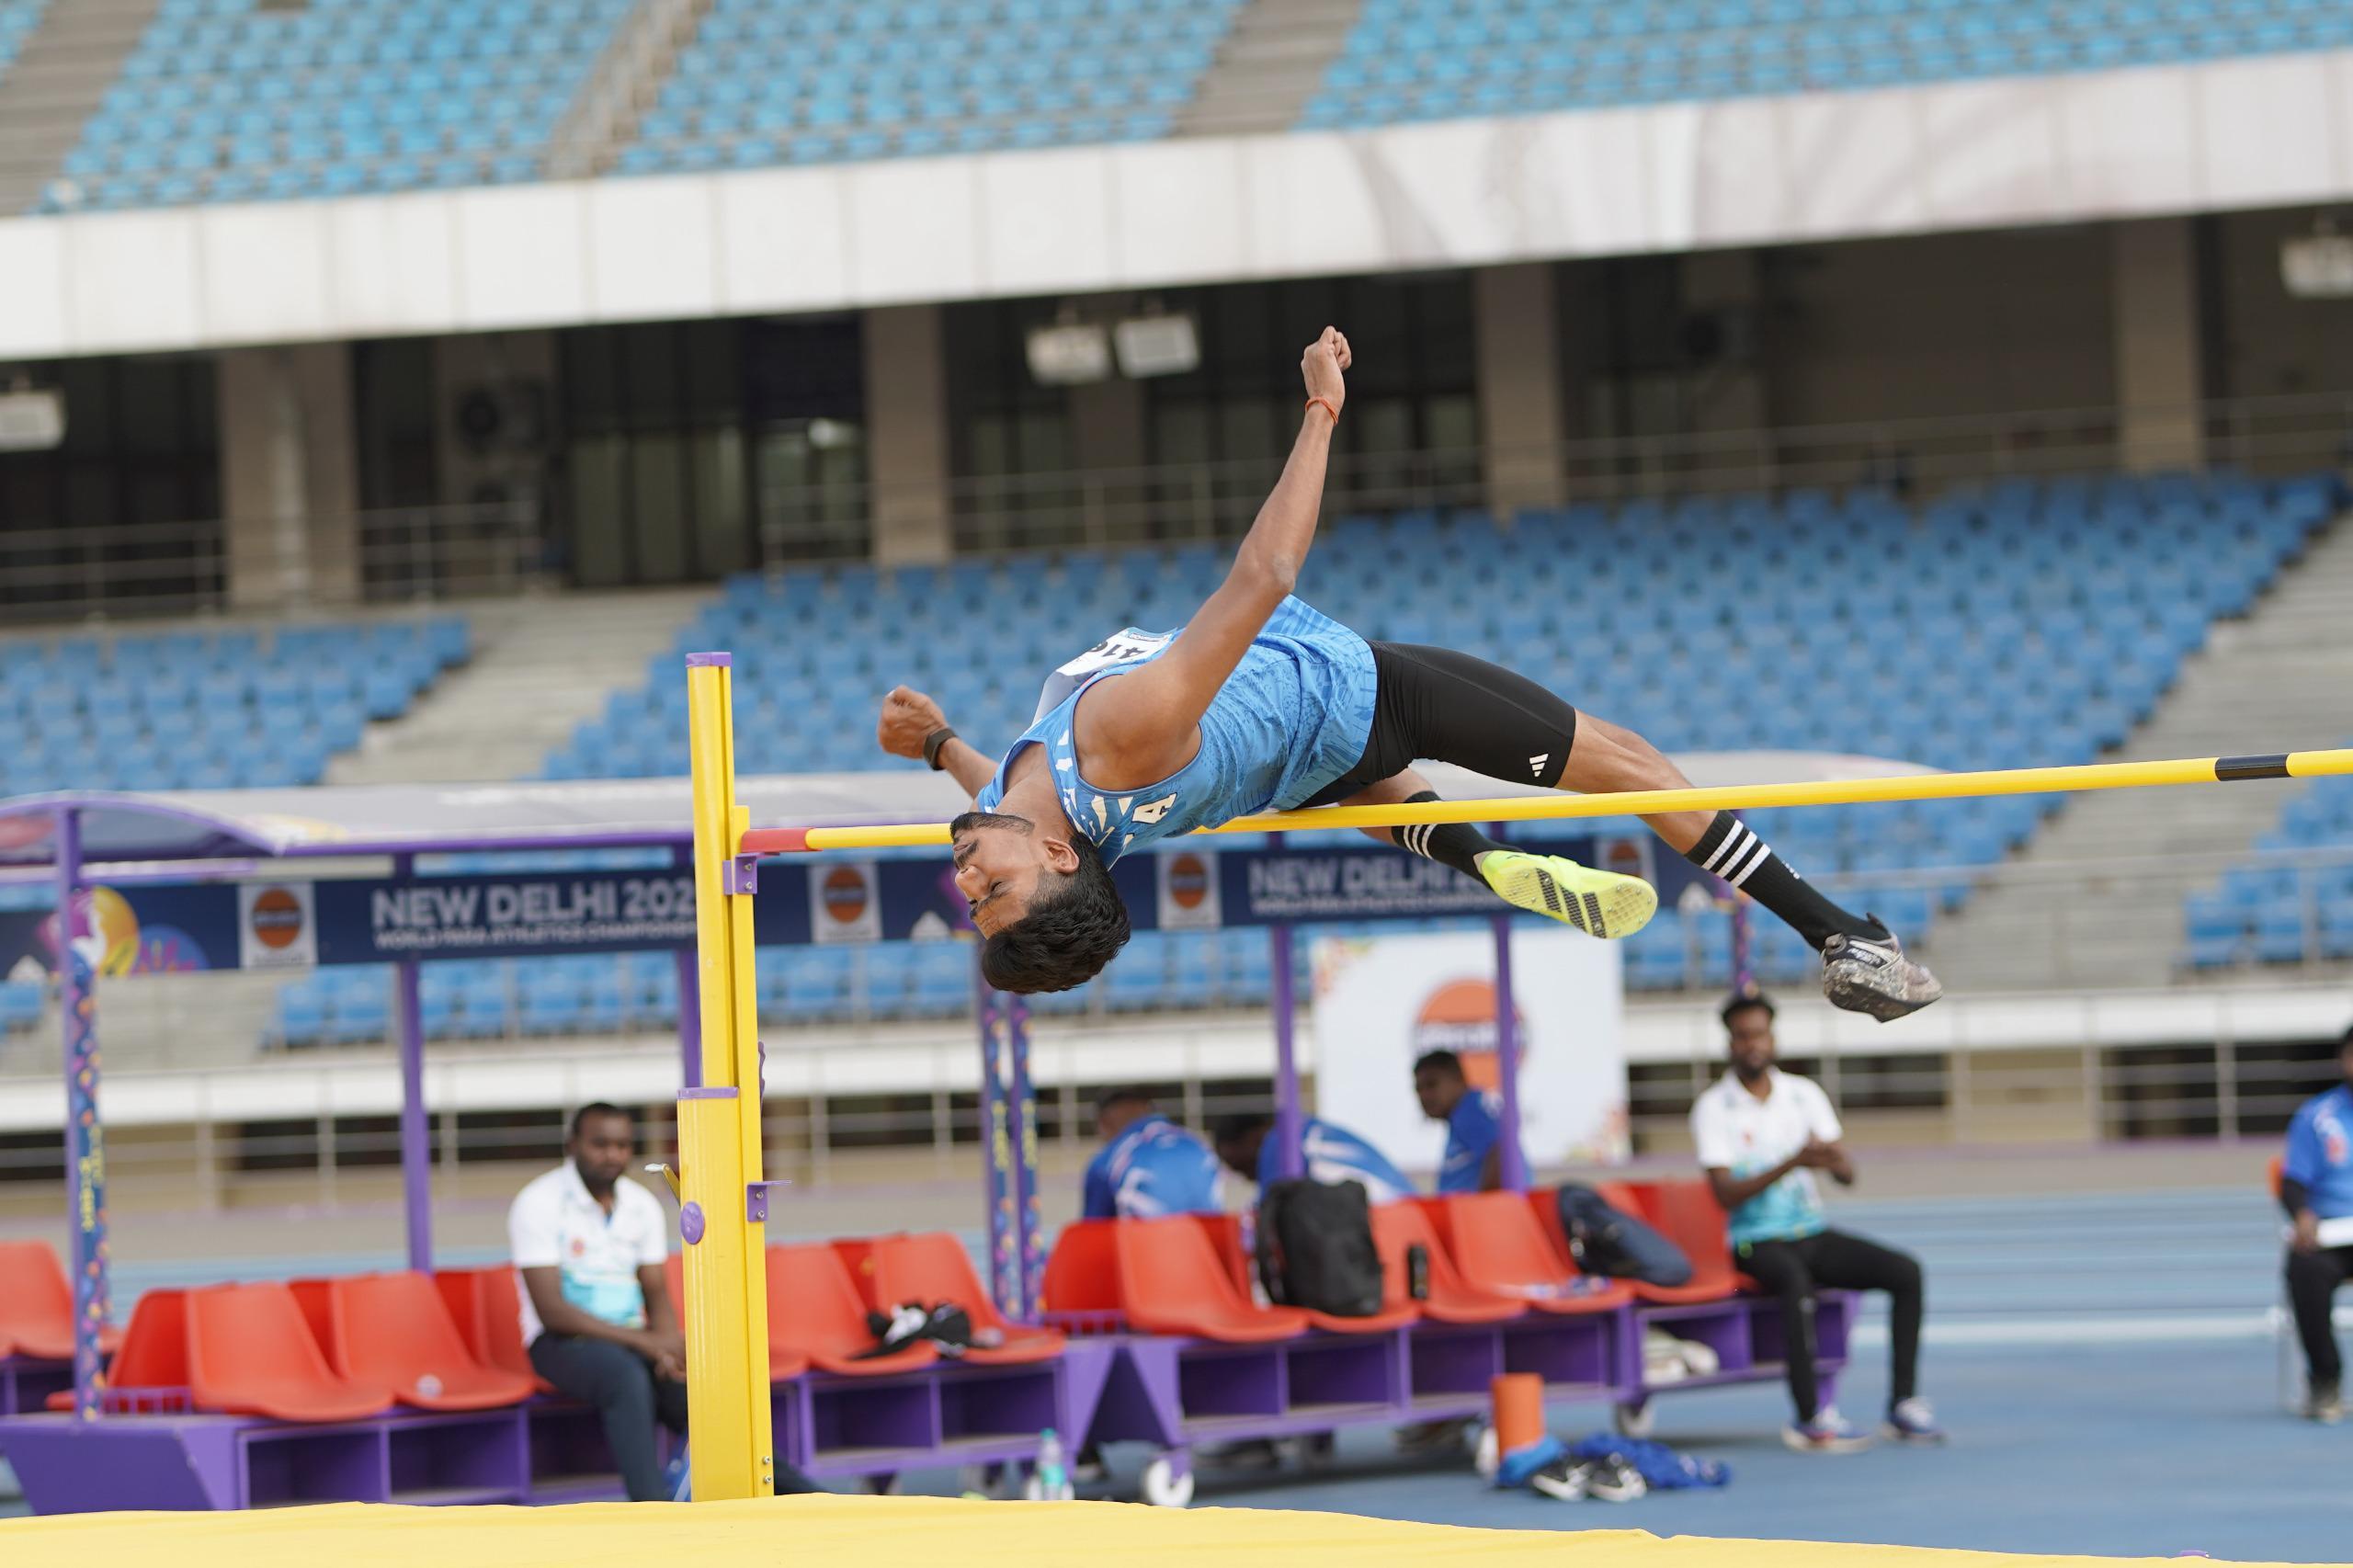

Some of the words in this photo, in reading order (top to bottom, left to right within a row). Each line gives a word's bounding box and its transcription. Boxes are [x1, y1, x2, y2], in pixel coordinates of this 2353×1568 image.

[1249, 857, 1338, 893] NEW
[372, 884, 480, 927] NEW
[485, 880, 619, 922] DELHI
[622, 878, 697, 919] 202
